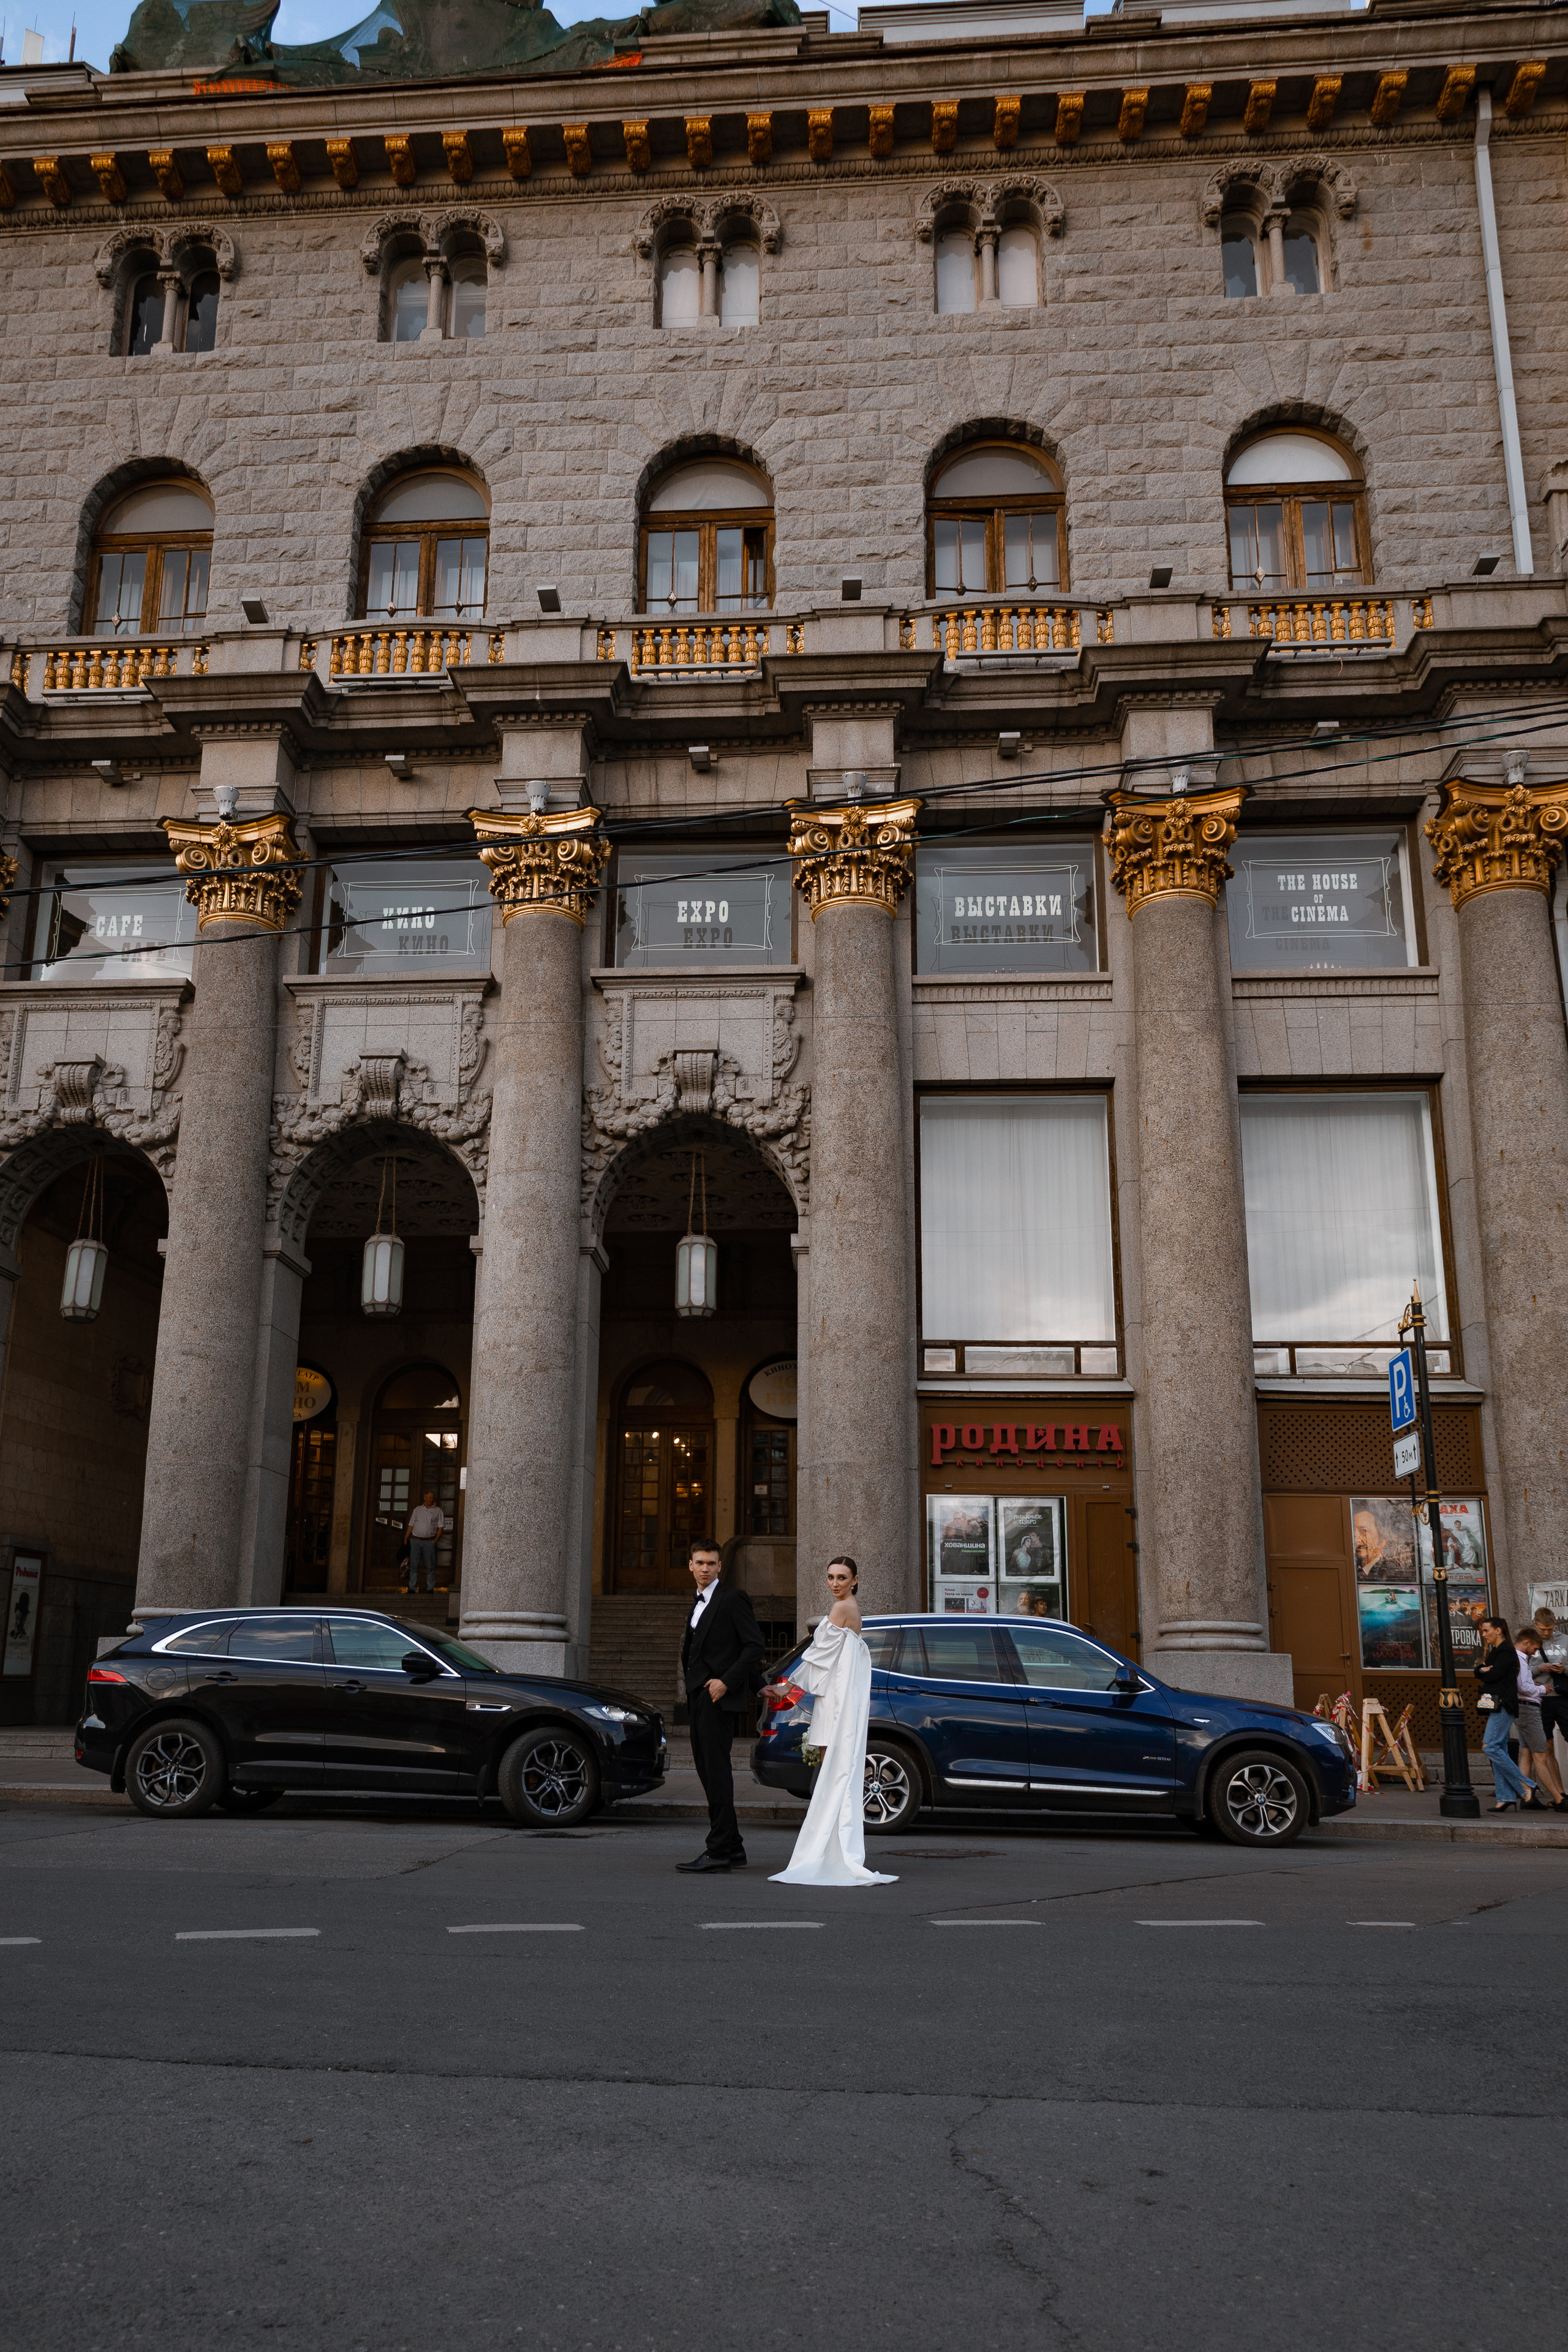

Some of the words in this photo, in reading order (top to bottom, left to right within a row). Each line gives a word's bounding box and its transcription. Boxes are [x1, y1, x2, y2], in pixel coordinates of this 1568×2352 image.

[1278, 875, 1305, 891] THE
[1312, 873, 1358, 891] HOUSE
[954, 895, 1062, 917] ВЫСТАВКИ
[1313, 894, 1323, 904] OF
[382, 907, 435, 930] КИНО
[677, 901, 729, 923] EXPO
[1291, 905, 1349, 922] CINEMA
[96, 915, 143, 937] CAFE
[764, 1363, 797, 1376] КИНОТ
[771, 1376, 797, 1392] ДО
[1393, 1361, 1407, 1419] P
[1439, 1504, 1469, 1514] АХА
[1451, 1629, 1482, 1647] ТРОВКА
[1372, 1651, 1416, 1659] ИЛЛЮЗИЙ
